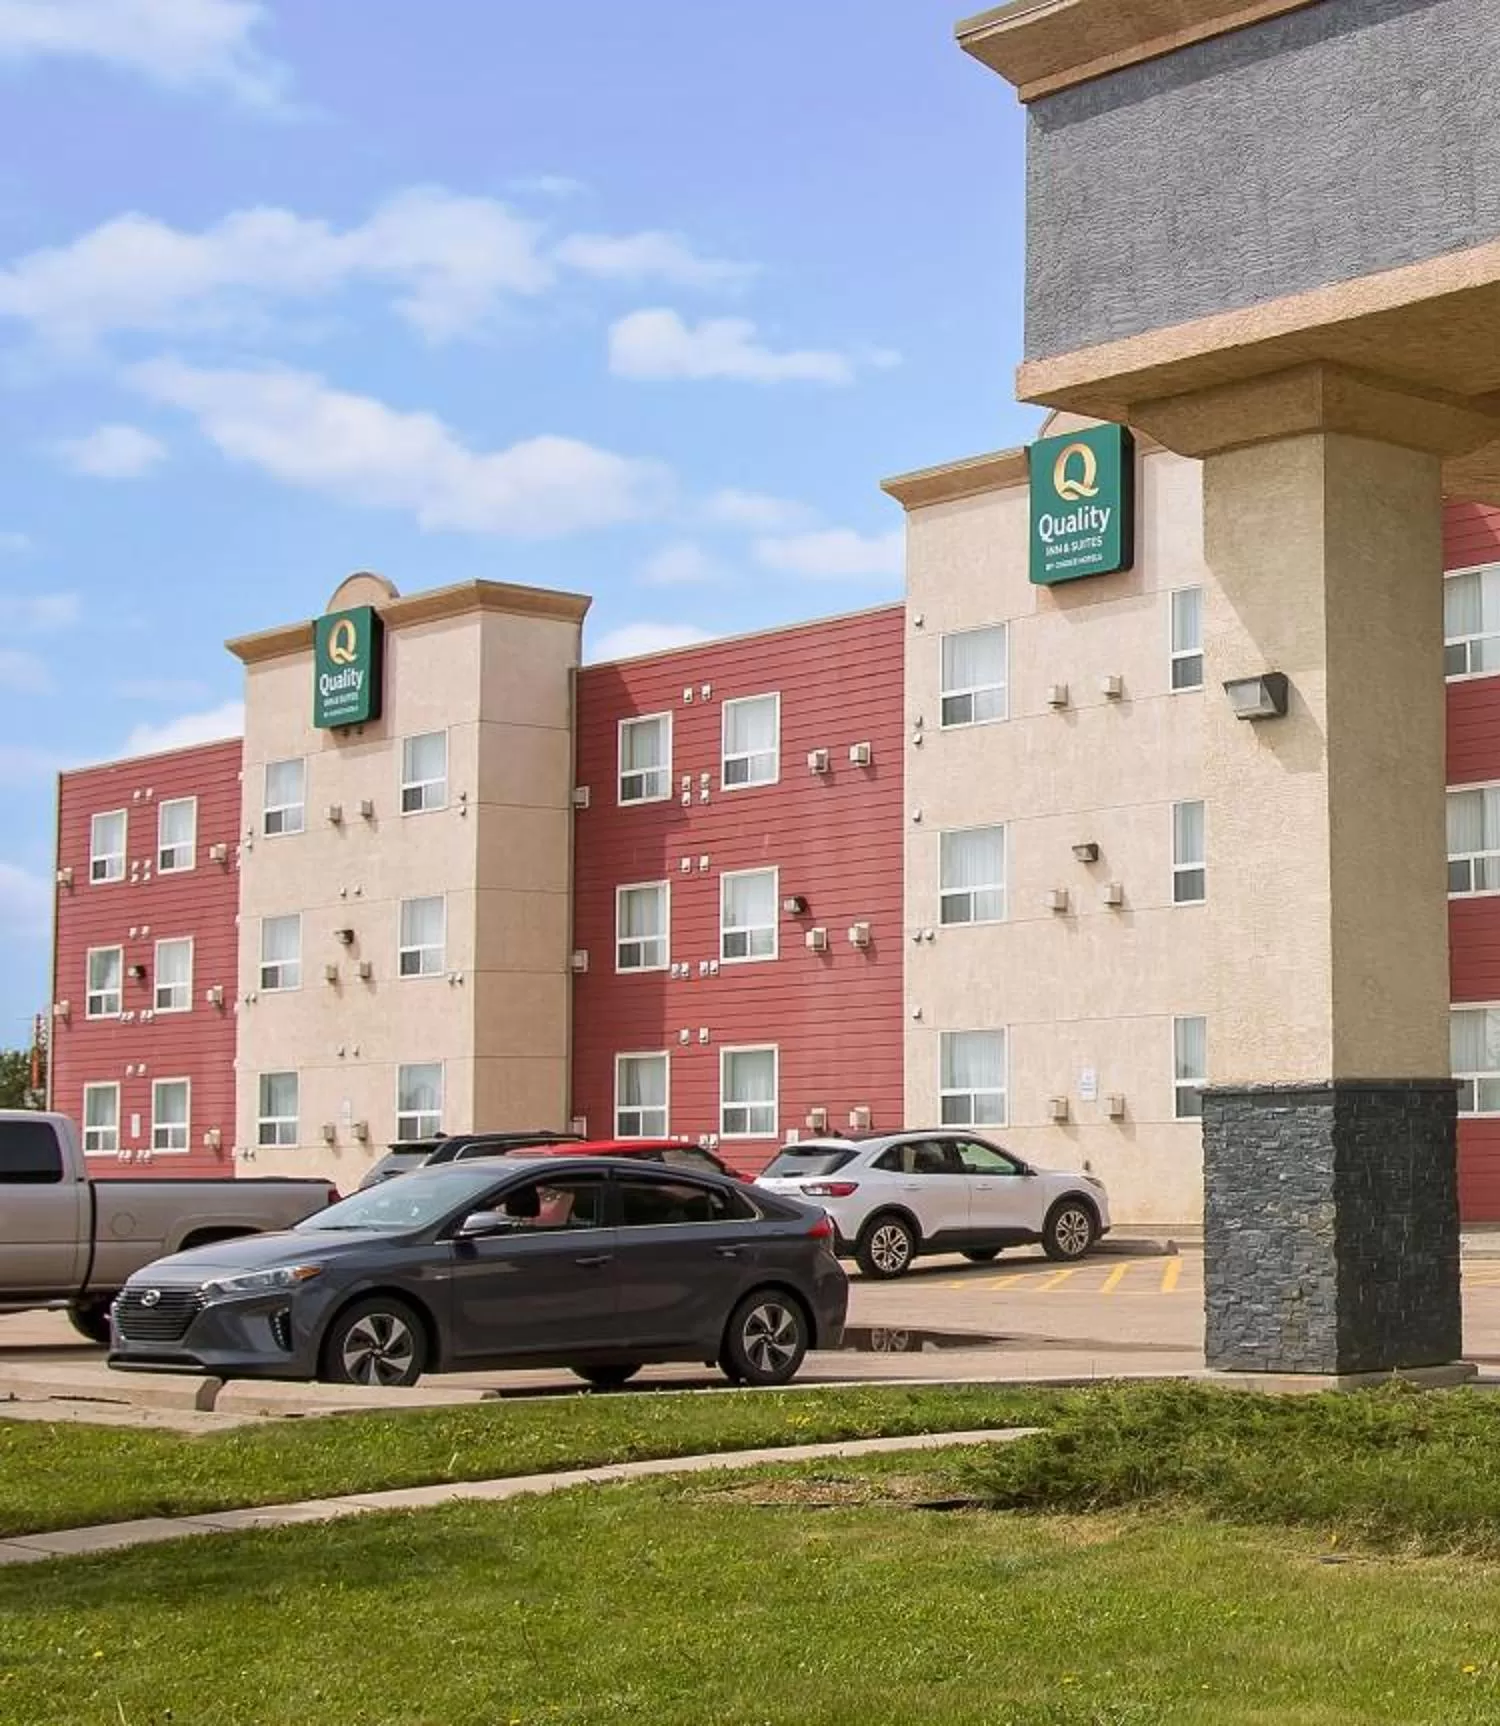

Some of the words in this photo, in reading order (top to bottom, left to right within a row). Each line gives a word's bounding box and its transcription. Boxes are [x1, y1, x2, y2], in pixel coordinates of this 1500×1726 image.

[1053, 442, 1100, 501] Q
[1038, 505, 1111, 543] Quality
[1045, 543, 1063, 557] INN
[1071, 535, 1103, 553] SUITES
[329, 619, 358, 665] Q
[319, 667, 365, 697] Quality
